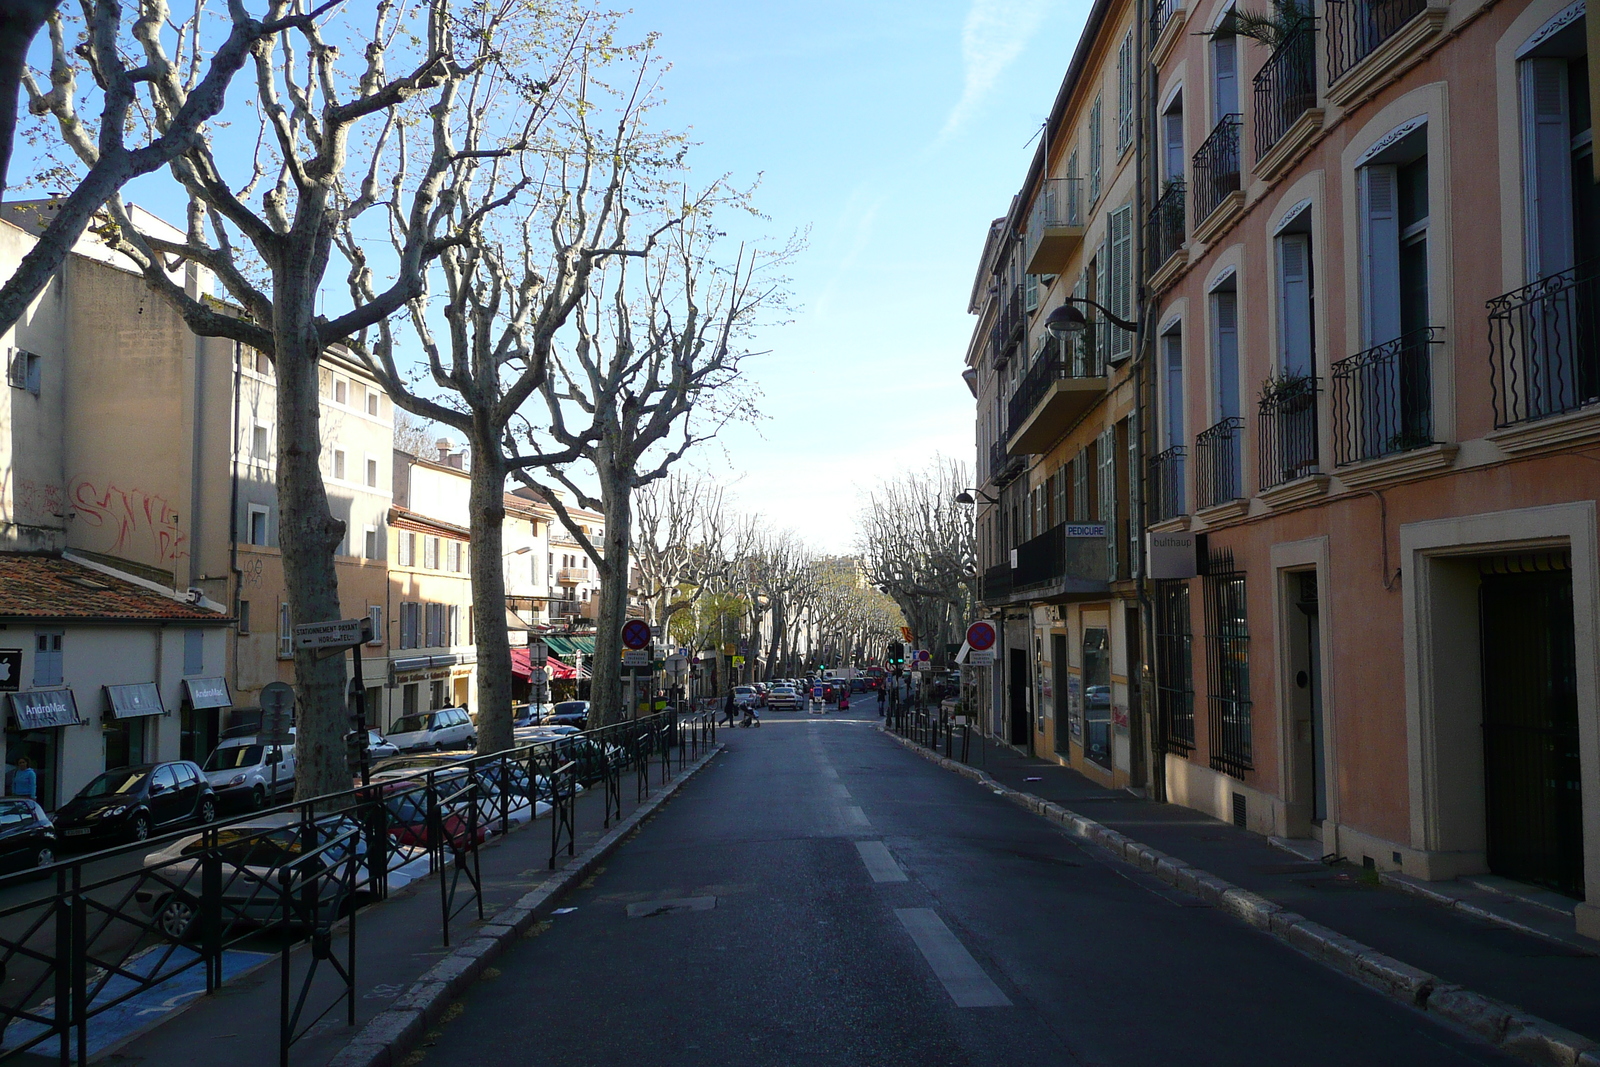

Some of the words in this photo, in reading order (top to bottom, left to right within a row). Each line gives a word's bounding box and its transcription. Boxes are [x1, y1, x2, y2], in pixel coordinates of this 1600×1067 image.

[1068, 526, 1104, 536] PEDICURE
[1154, 537, 1192, 548] bulthaup
[296, 625, 336, 636] STATIONNEMENT
[338, 623, 358, 632] PAYANT
[26, 703, 66, 715] AndroMac
